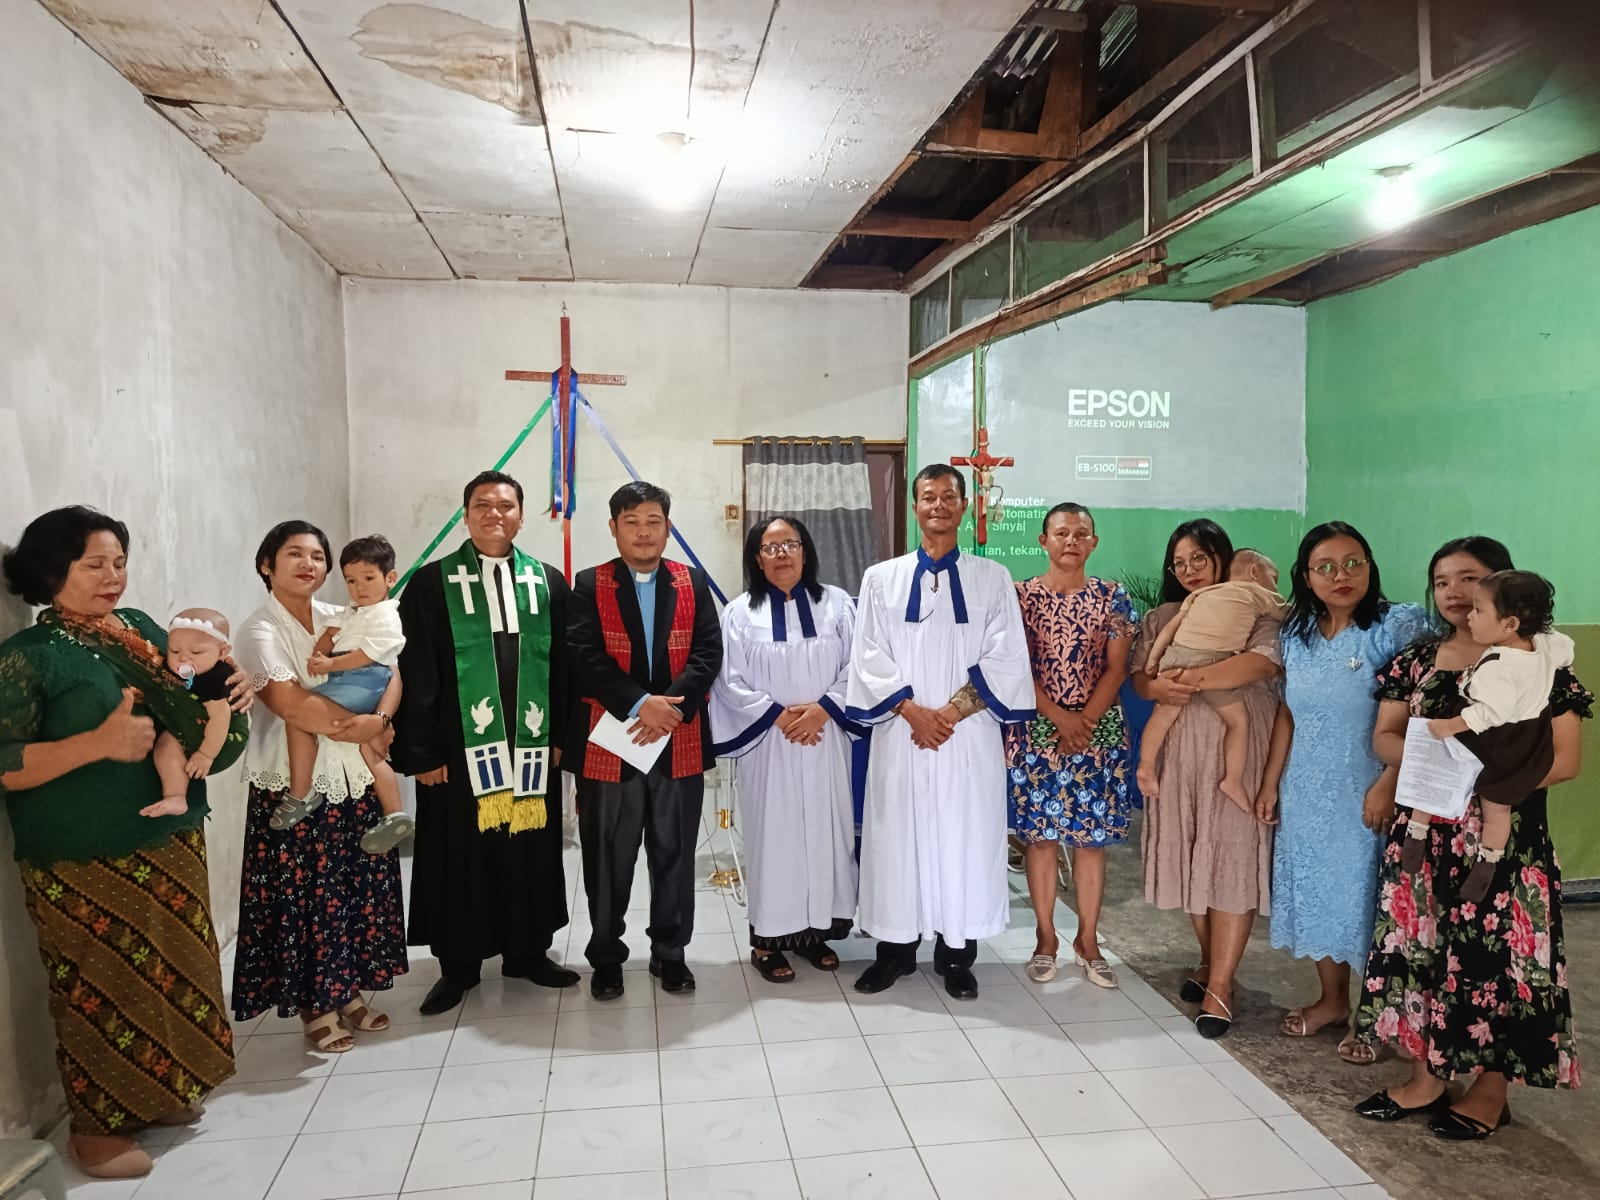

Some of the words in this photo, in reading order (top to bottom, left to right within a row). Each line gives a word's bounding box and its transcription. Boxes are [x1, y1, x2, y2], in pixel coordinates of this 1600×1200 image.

[1068, 389, 1170, 418] EPSON
[1067, 418, 1107, 429] EXCEED
[1109, 419, 1136, 429] YOUR
[1138, 420, 1170, 430] VISION
[1009, 544, 1042, 556] tekan
